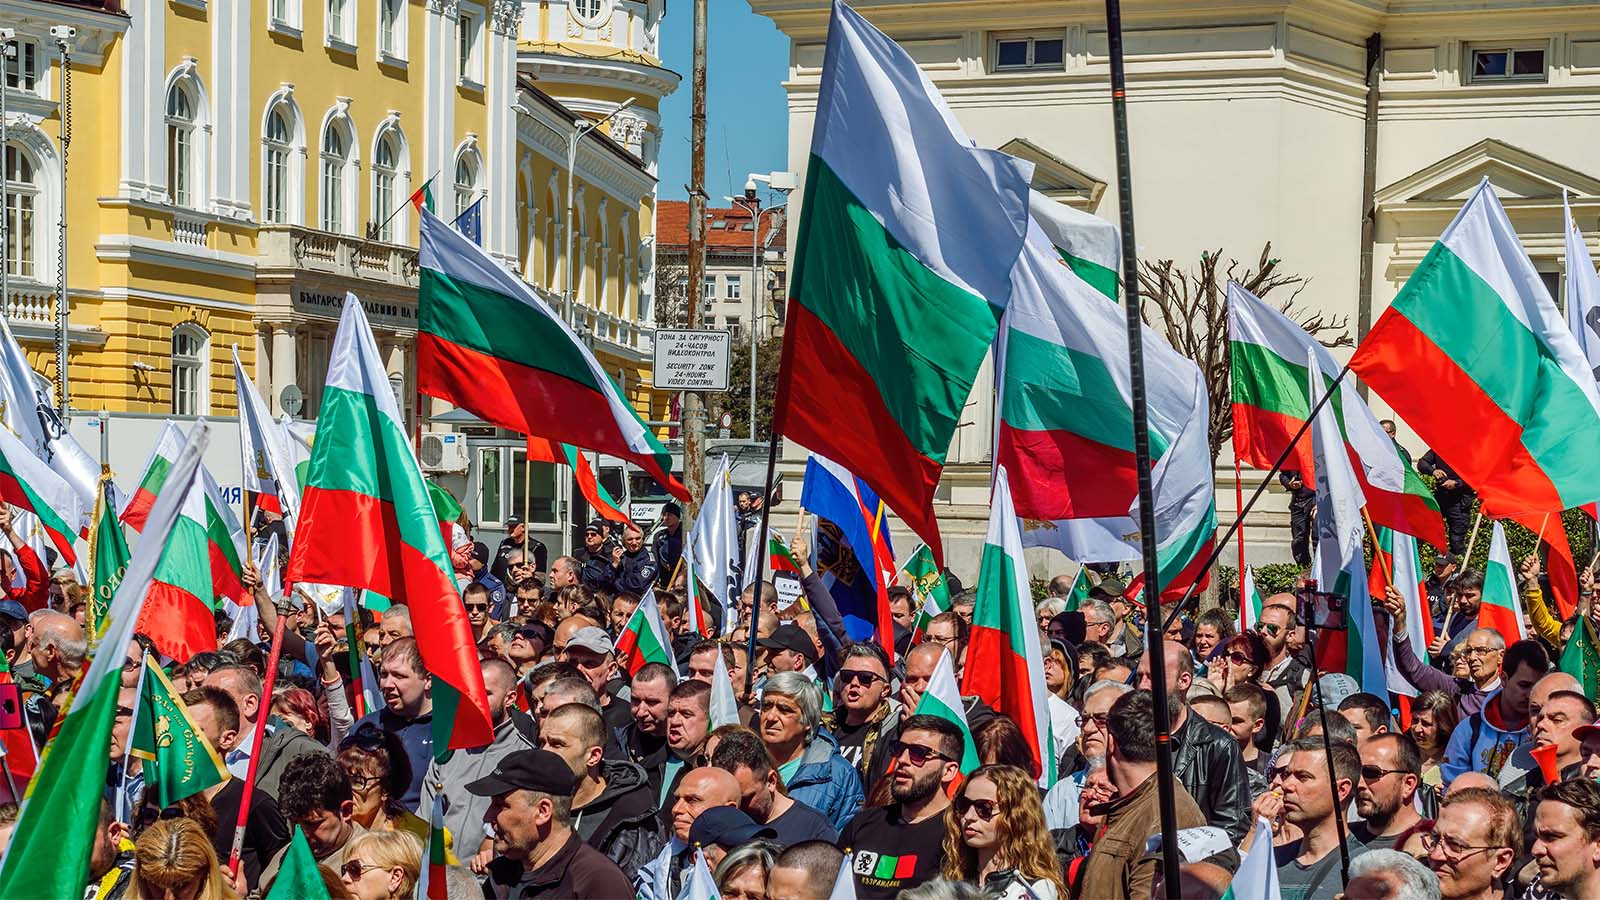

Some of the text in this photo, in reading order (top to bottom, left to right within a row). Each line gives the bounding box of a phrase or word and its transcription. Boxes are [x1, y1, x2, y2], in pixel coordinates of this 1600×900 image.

[300, 291, 344, 309] БЪЛГАРСК
[689, 334, 724, 342] СИГУРНОСТ
[668, 349, 716, 357] ВИДЕОКОНТРОЛ
[667, 378, 686, 386] VIDEO
